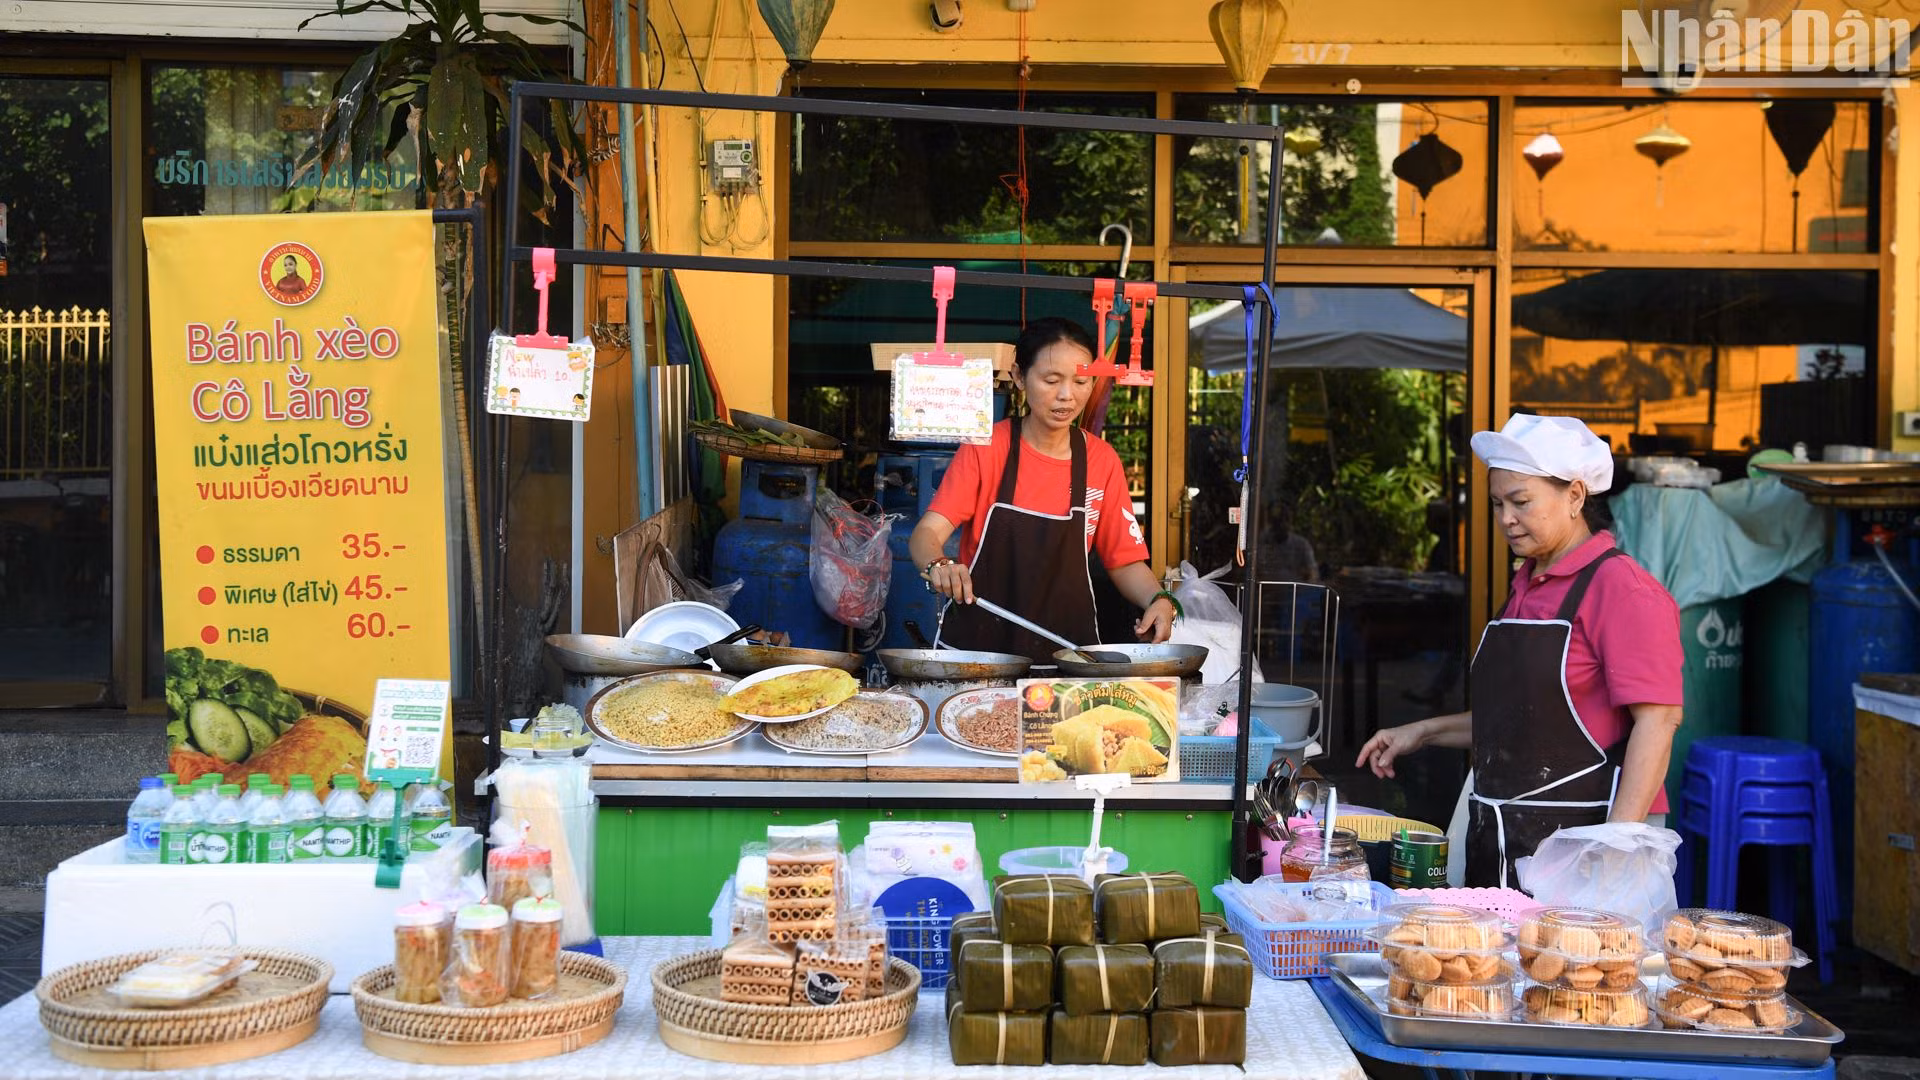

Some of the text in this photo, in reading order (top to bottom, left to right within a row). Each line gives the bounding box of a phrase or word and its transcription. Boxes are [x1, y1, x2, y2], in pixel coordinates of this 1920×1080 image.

[264, 278, 320, 303] VIETNAM FOOD
[186, 316, 400, 364] Bánh xèo
[192, 364, 371, 428] Cô Lằng
[196, 466, 409, 501] ขนมเบื้องเวียดนาม
[223, 546, 300, 563] ธรรมดา
[224, 585, 277, 605] พิเศษ
[282, 580, 339, 607] (ใส่ไข่)
[227, 626, 270, 644] ทะเล
[1427, 866, 1448, 877] COLL
